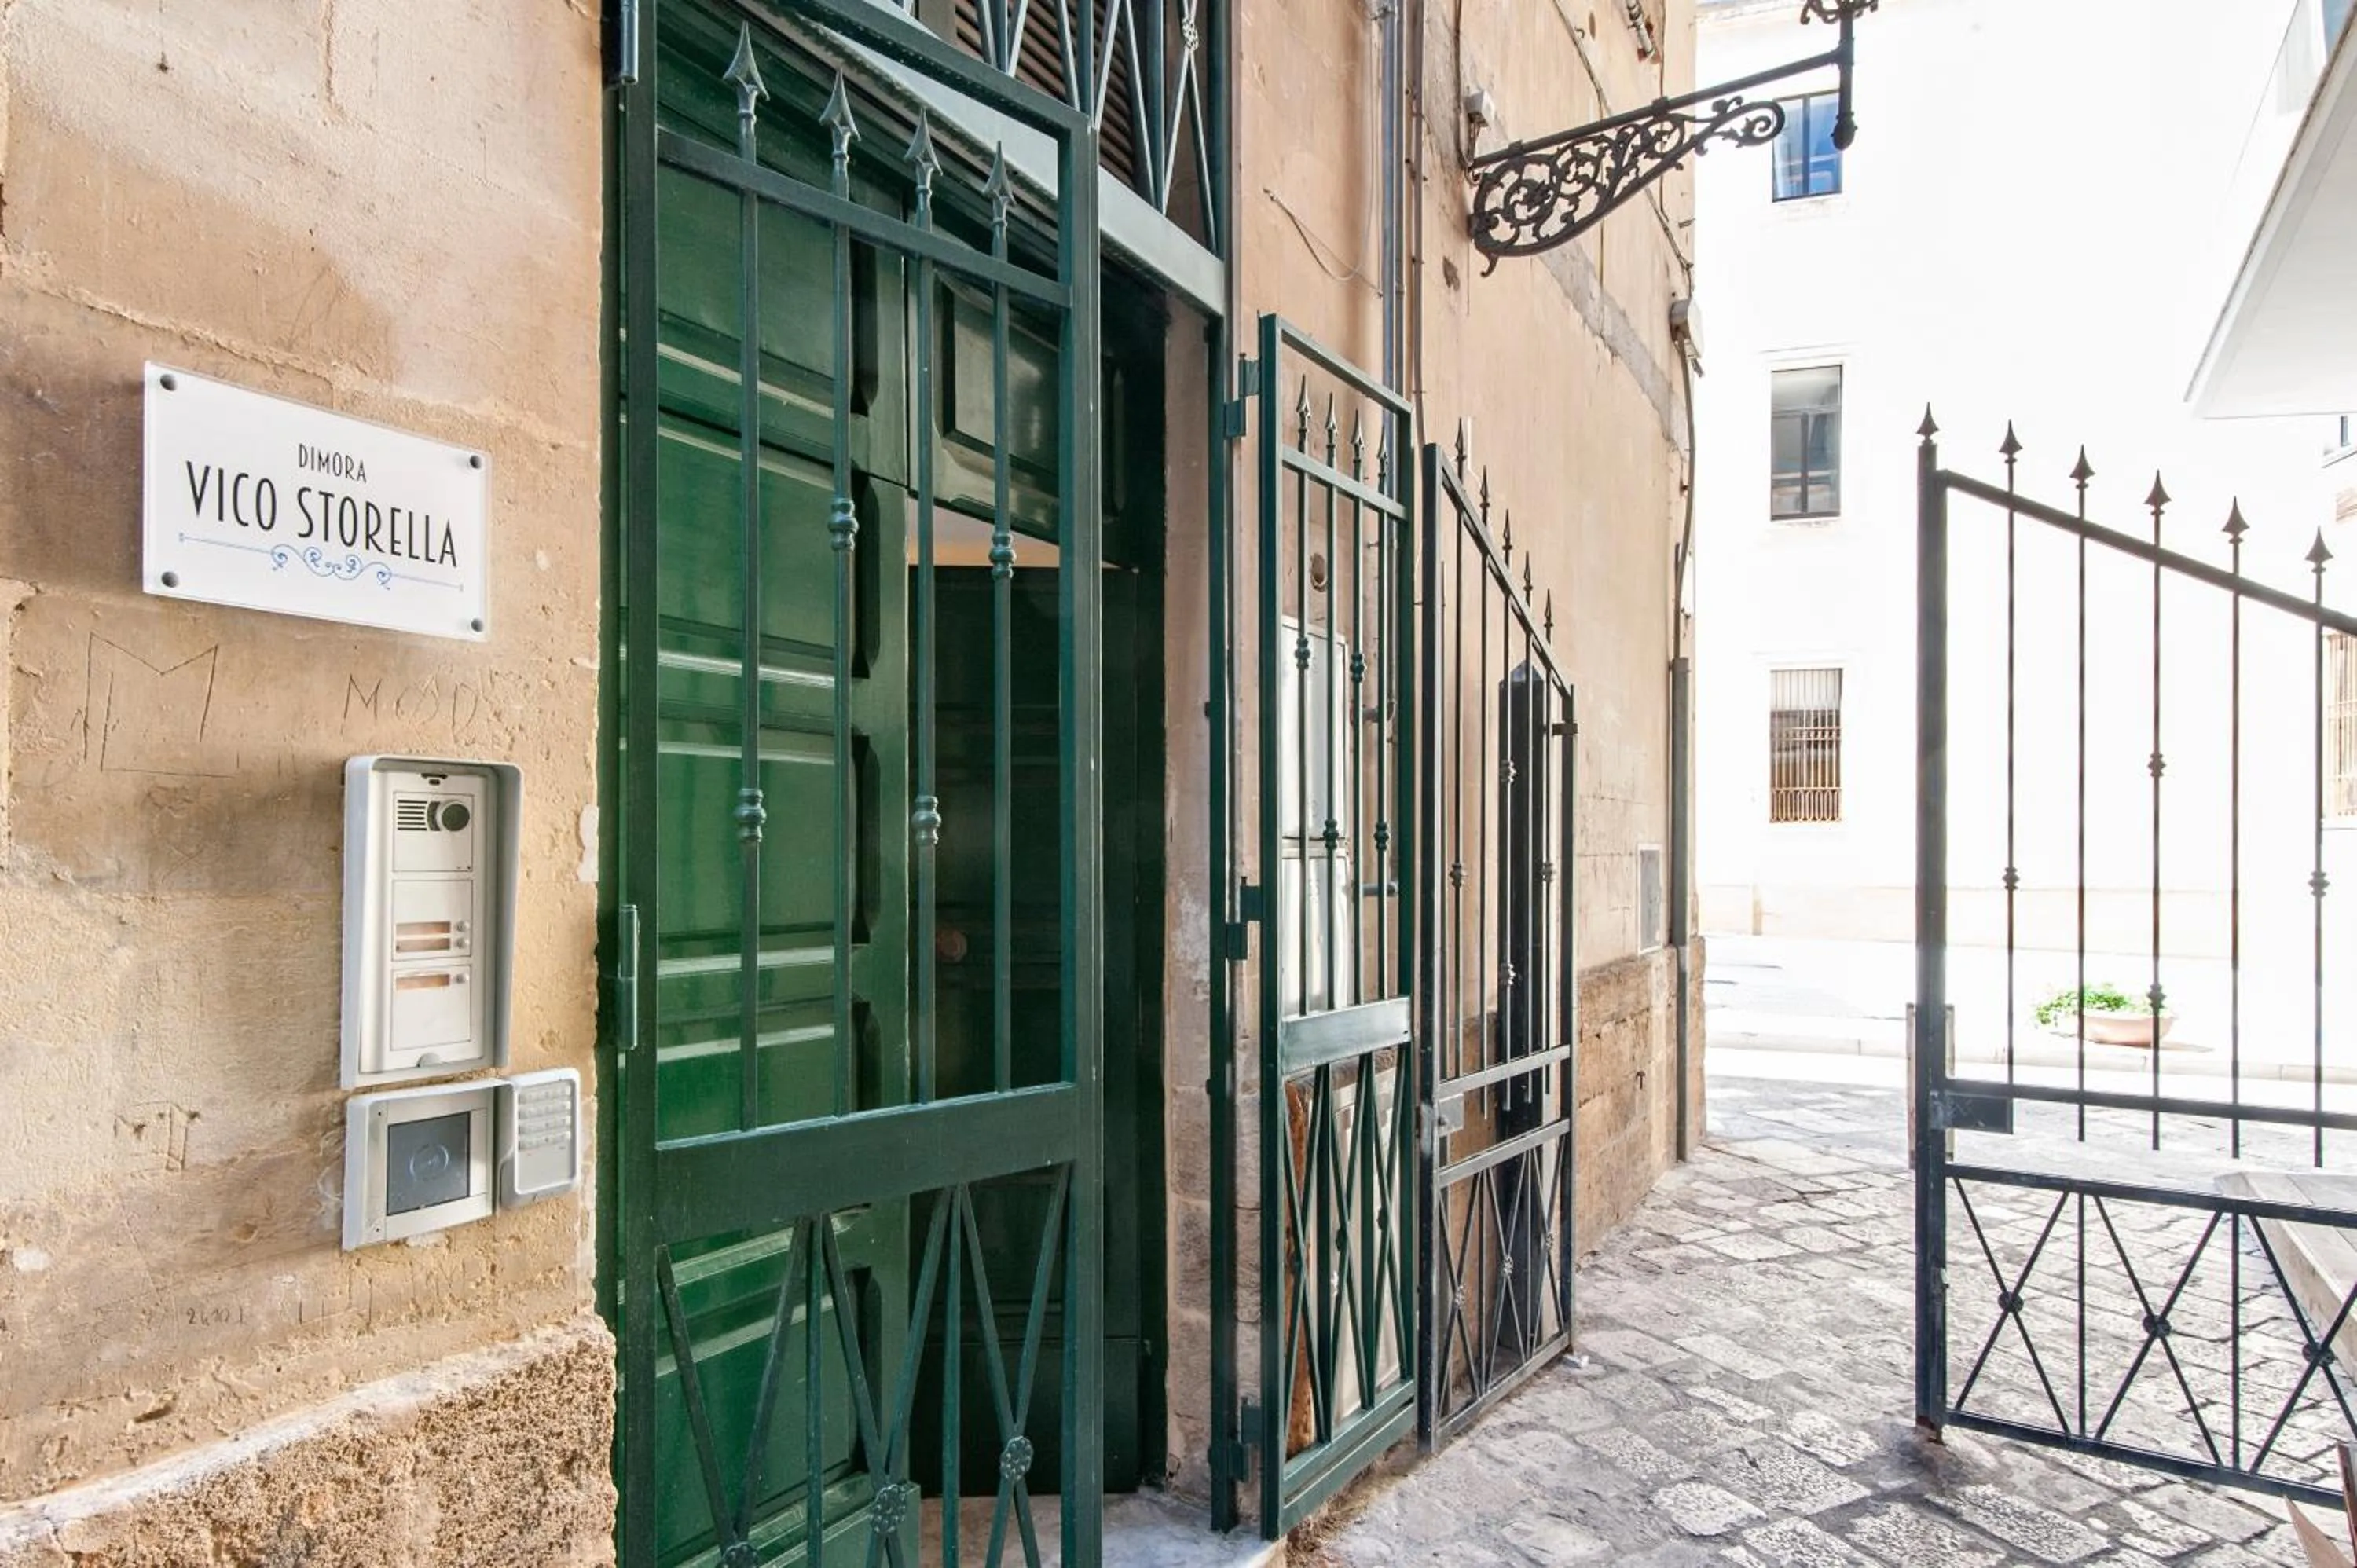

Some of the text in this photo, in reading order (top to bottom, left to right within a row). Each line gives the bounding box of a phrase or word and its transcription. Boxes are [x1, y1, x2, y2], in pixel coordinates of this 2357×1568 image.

[298, 442, 368, 484] DIMORA
[185, 460, 459, 568] VICO STORELLA
